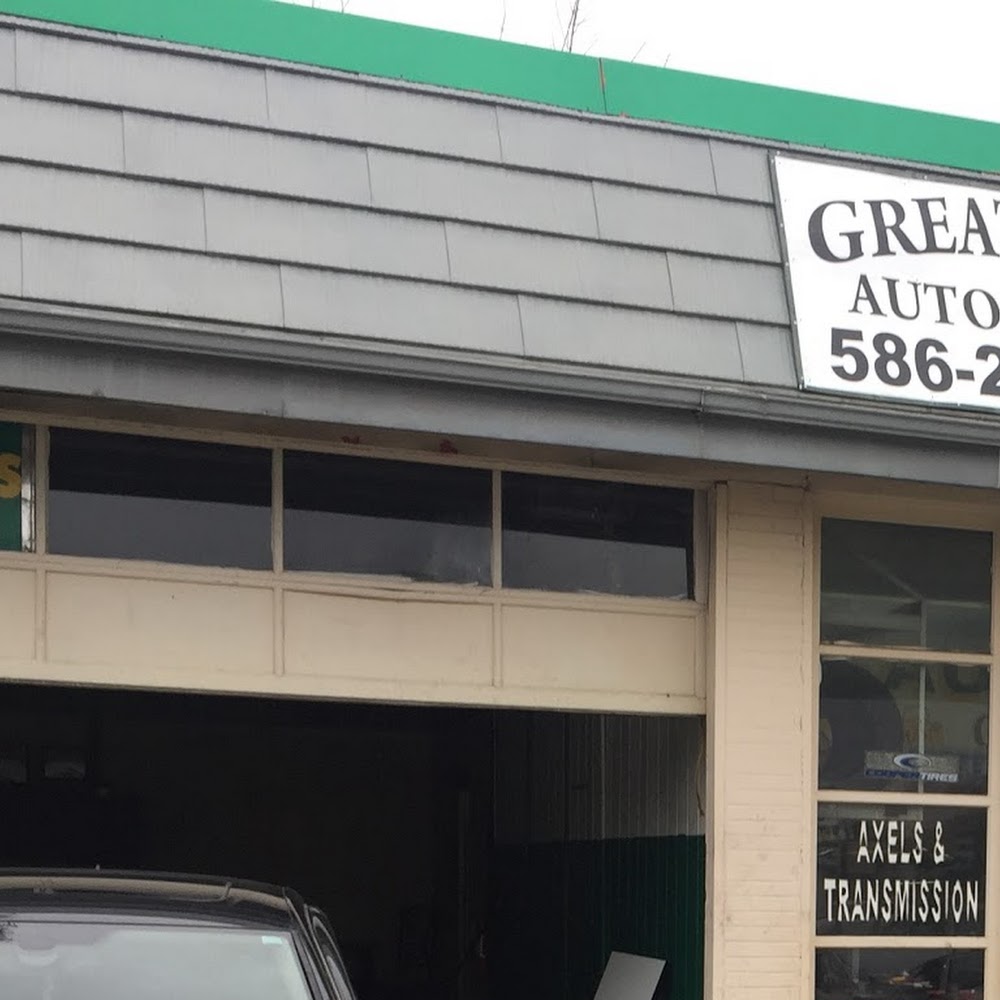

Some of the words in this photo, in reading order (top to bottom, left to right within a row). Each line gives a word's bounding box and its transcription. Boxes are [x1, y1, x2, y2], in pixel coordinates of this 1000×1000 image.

[848, 274, 1000, 329] AUTO
[857, 820, 924, 864] AXELS
[933, 821, 945, 864] &
[824, 878, 978, 923] TRANSMISSION
